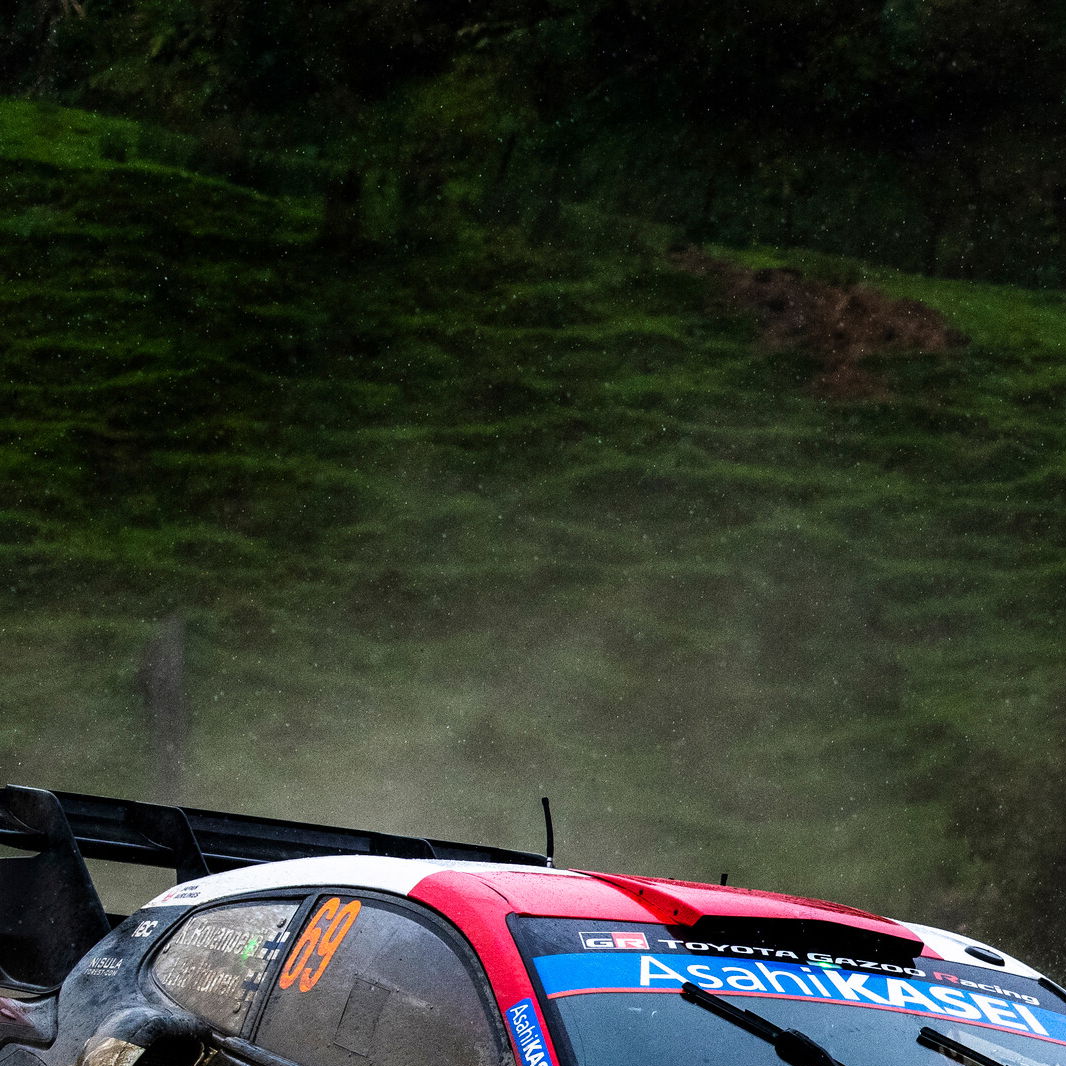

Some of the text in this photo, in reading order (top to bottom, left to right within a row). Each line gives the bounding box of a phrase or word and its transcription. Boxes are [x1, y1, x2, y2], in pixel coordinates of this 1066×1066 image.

[88, 957, 124, 969] NISULA
[279, 897, 361, 993] 69
[584, 936, 1041, 1006] GR TOYOTA GAZOO Racing
[639, 955, 1050, 1036] AsahiKASEI
